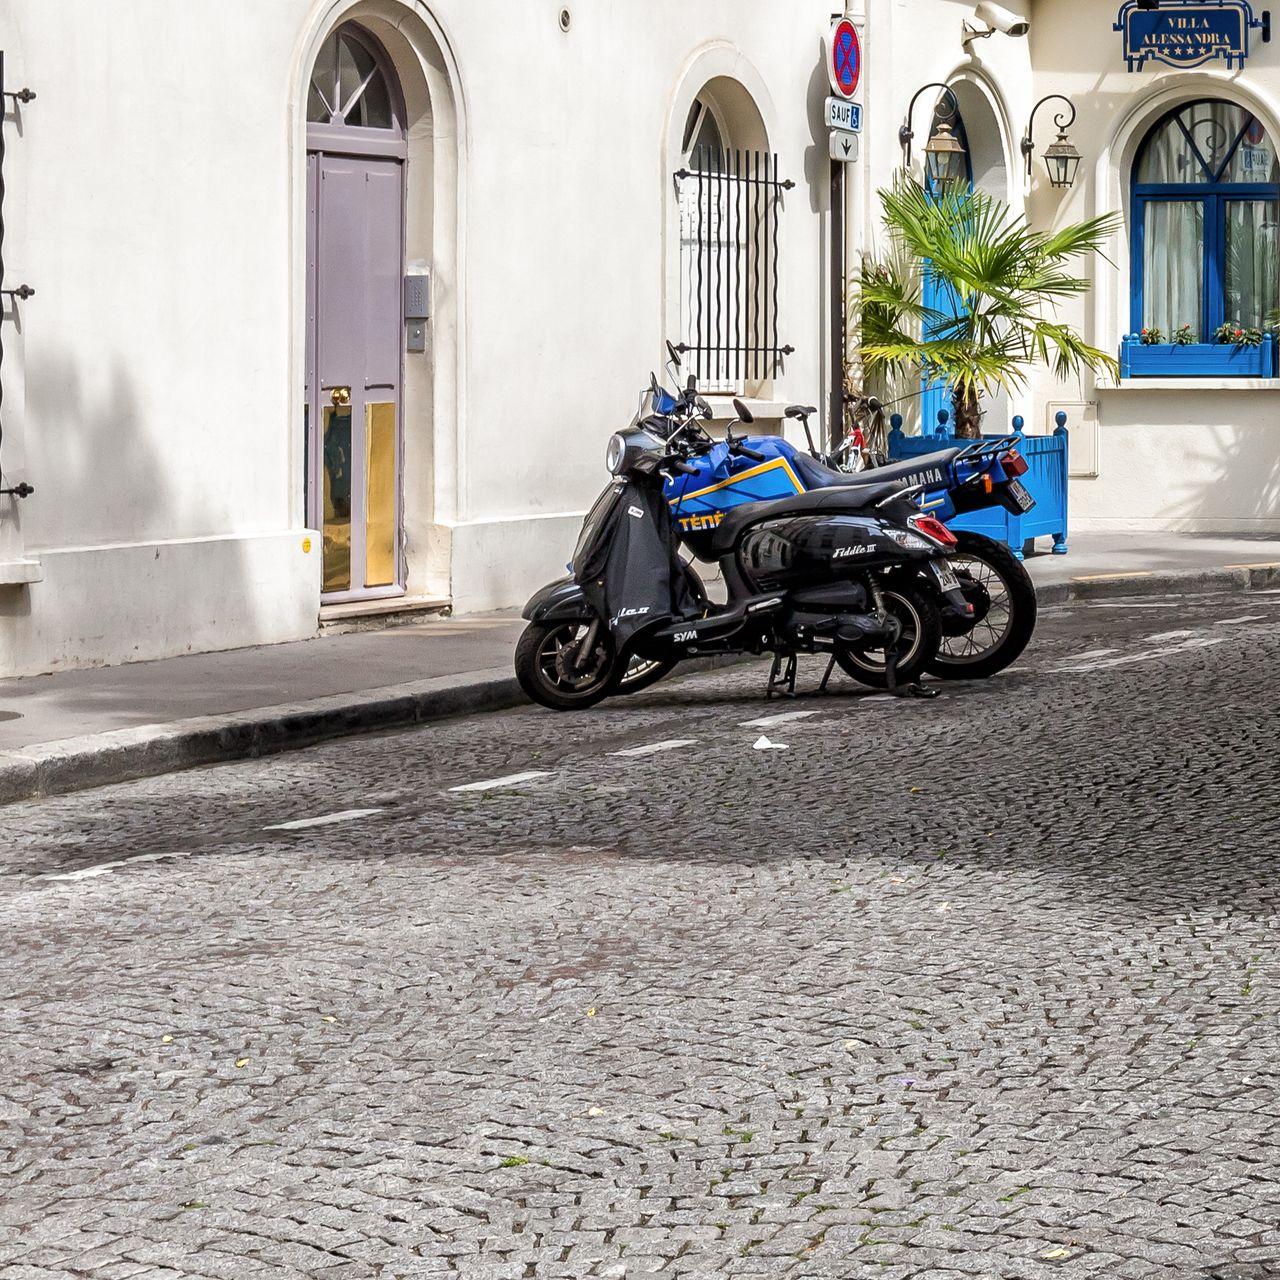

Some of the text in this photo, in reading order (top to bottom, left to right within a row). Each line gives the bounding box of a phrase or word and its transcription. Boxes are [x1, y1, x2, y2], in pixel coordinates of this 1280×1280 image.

[1168, 18, 1210, 29] VILLA
[1142, 33, 1231, 45] ALESSANDRA
[832, 104, 851, 123] SAUF
[833, 543, 877, 558] Fiddle III
[673, 630, 697, 643] SYM
